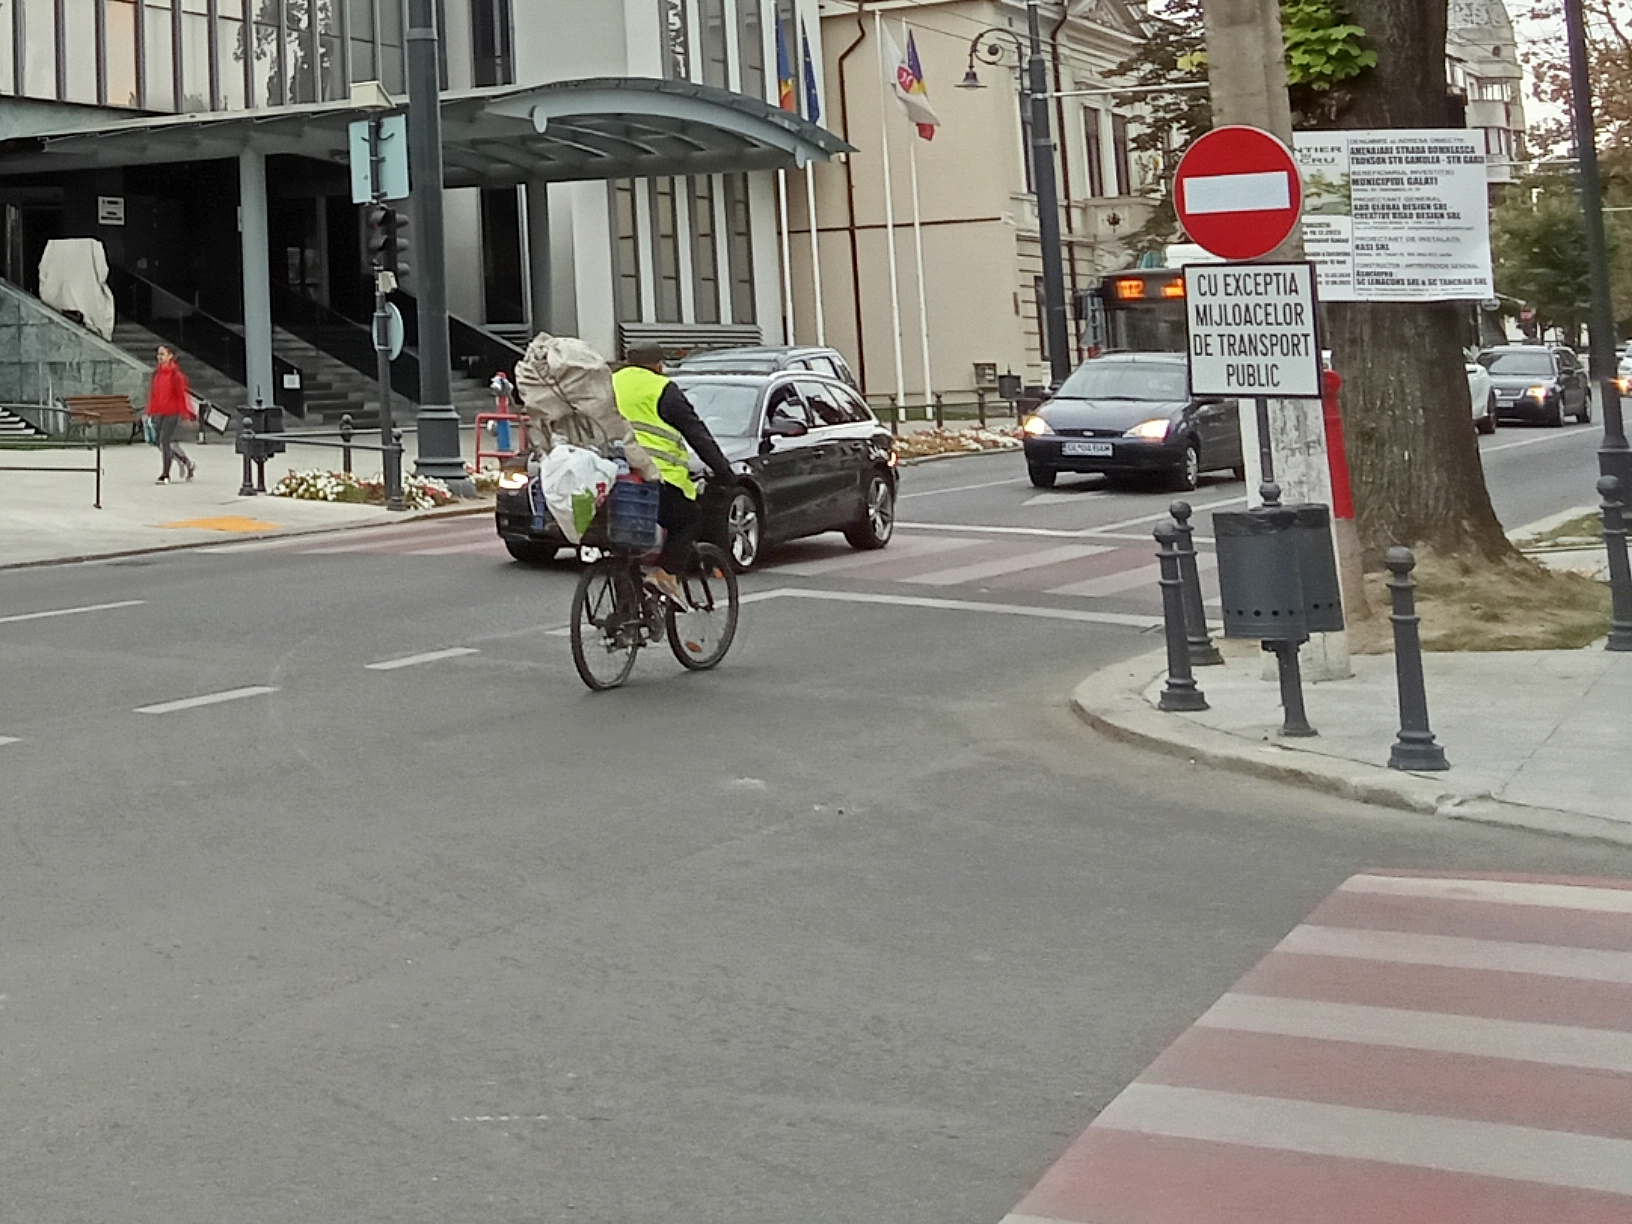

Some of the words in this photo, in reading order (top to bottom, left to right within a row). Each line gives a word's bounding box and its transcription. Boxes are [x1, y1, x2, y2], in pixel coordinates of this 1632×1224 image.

[1388, 157, 1403, 165] STR
[1446, 156, 1462, 164] STR
[1396, 146, 1426, 155] STRADA
[1351, 177, 1405, 186] MUNICIPIUL
[1406, 177, 1438, 186] GALATI
[1197, 274, 1218, 296] CU
[1223, 272, 1299, 296] EXCEPTIA
[1195, 303, 1305, 327] MIJLOACELOR
[1193, 334, 1213, 357] DE
[1217, 333, 1310, 357] TRANSPORT
[1226, 363, 1280, 387] PUBLIC
